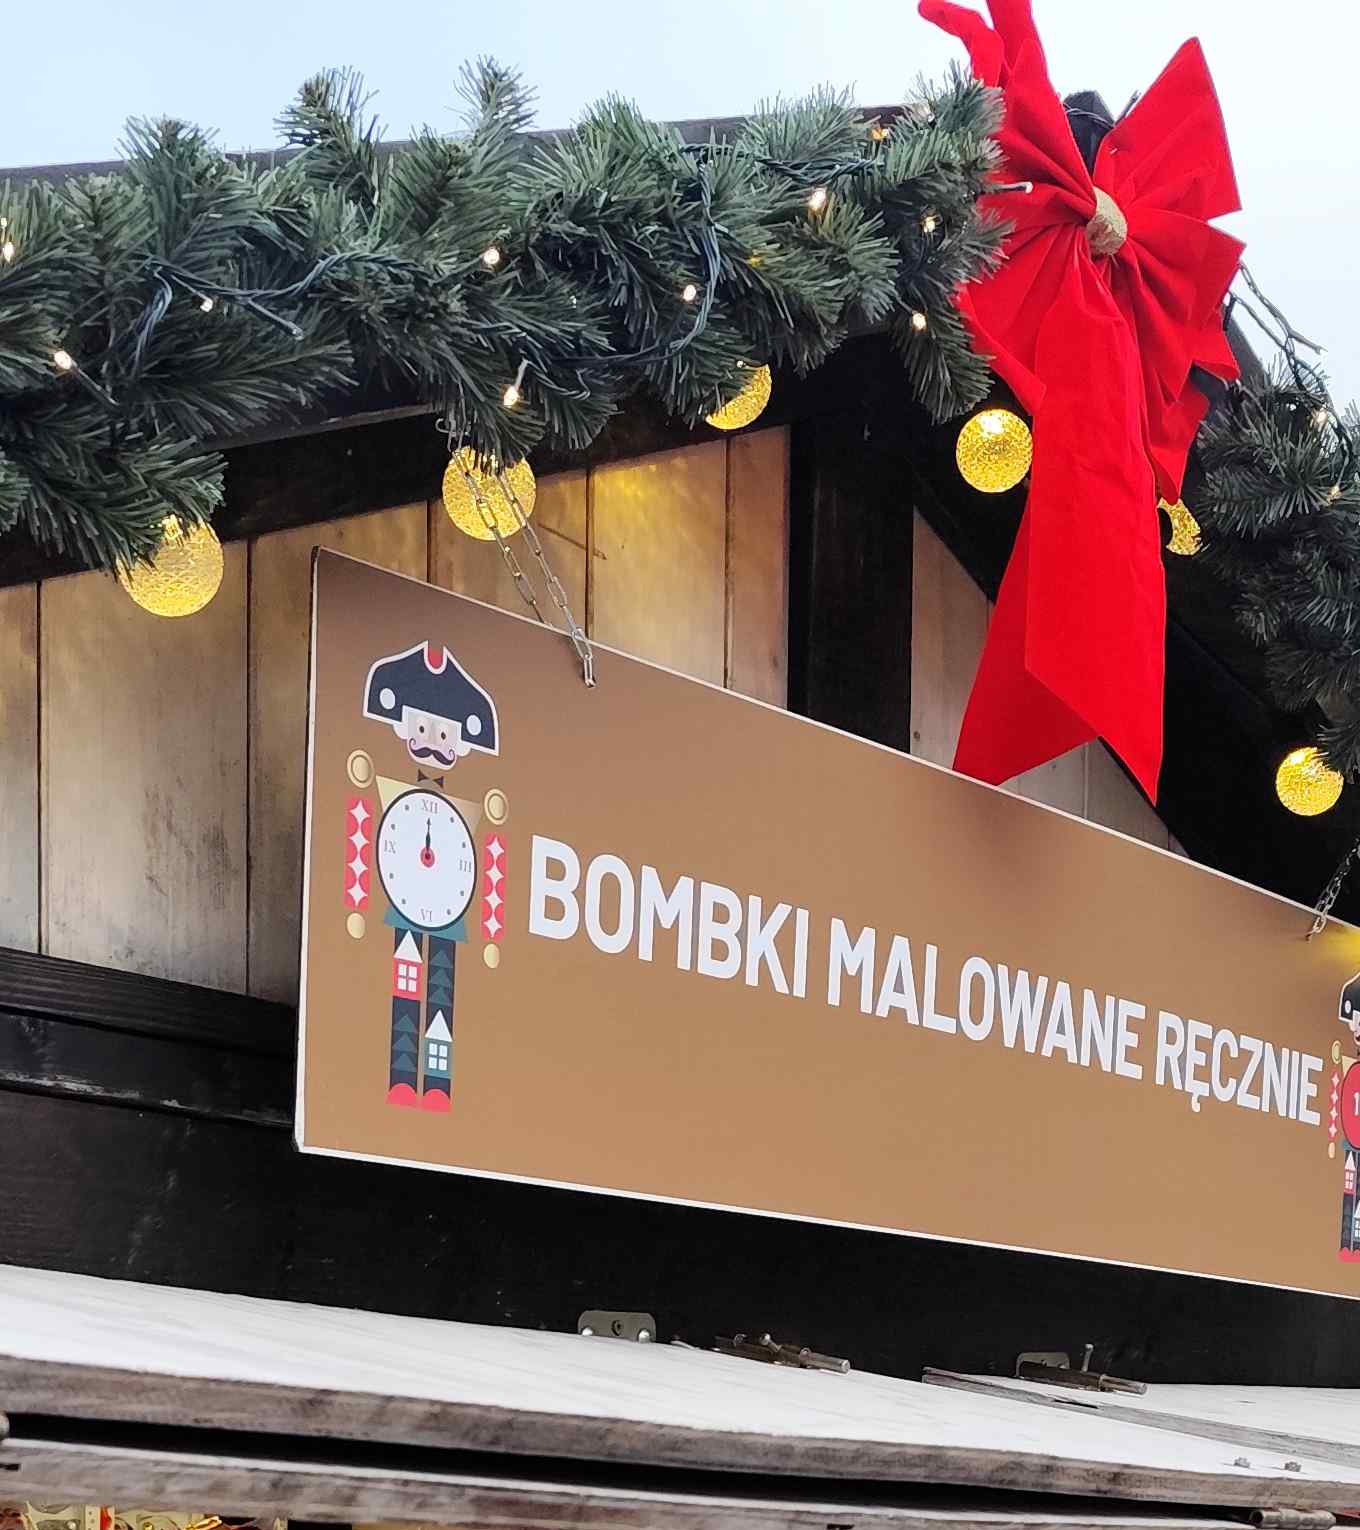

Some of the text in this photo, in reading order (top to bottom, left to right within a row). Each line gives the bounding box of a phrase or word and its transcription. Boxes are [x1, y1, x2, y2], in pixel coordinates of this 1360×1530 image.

[421, 798, 439, 814] XII
[528, 834, 1325, 1127] BOMBKI MALOWANE RĘCZNIE
